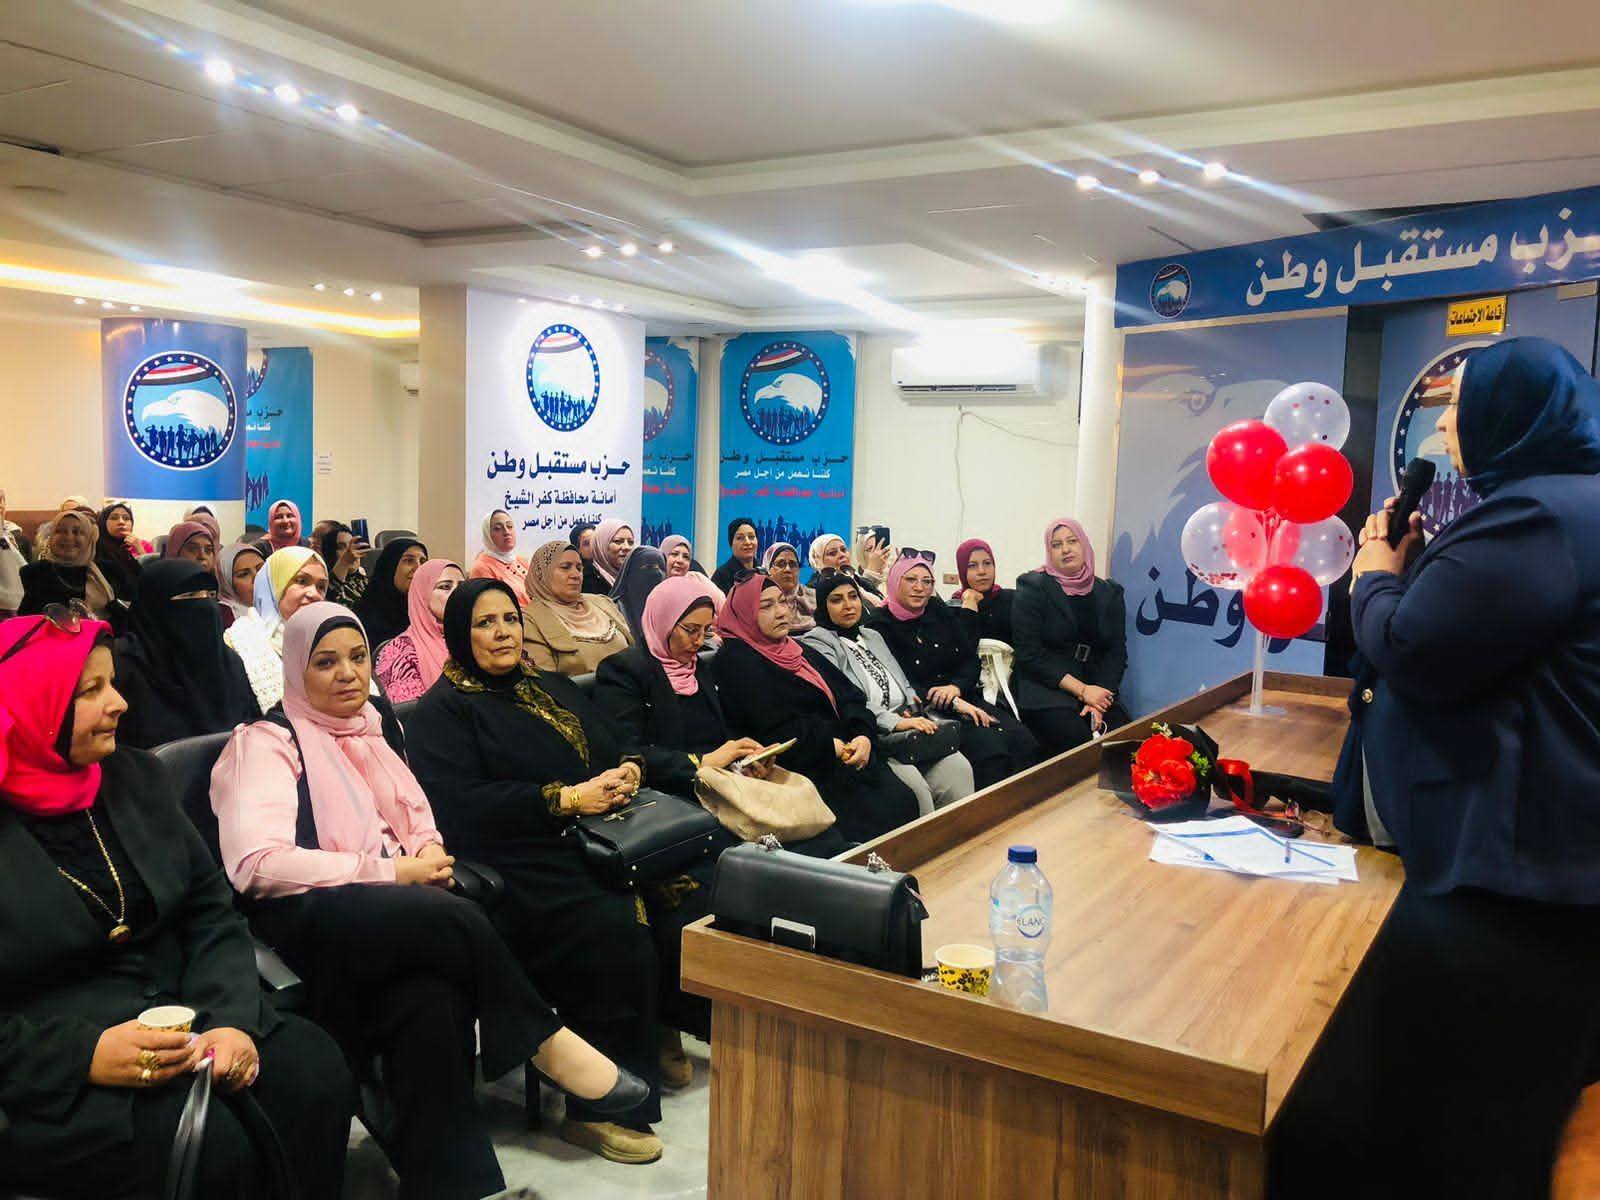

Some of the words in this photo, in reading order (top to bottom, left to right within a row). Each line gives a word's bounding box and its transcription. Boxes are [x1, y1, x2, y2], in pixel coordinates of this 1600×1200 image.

[1335, 227, 1499, 294] مستقبل
[1246, 250, 1328, 306] وطن
[487, 449, 526, 479] وطن
[529, 450, 587, 480] مستقبل
[590, 454, 631, 480] حزب
[811, 452, 849, 467] حزب
[504, 488, 534, 510] الشيخ
[536, 488, 553, 509] كفر
[554, 489, 589, 505] محافظة
[521, 517, 540, 531] مصر
[557, 514, 568, 530] من
[1136, 566, 1245, 648] وطن
